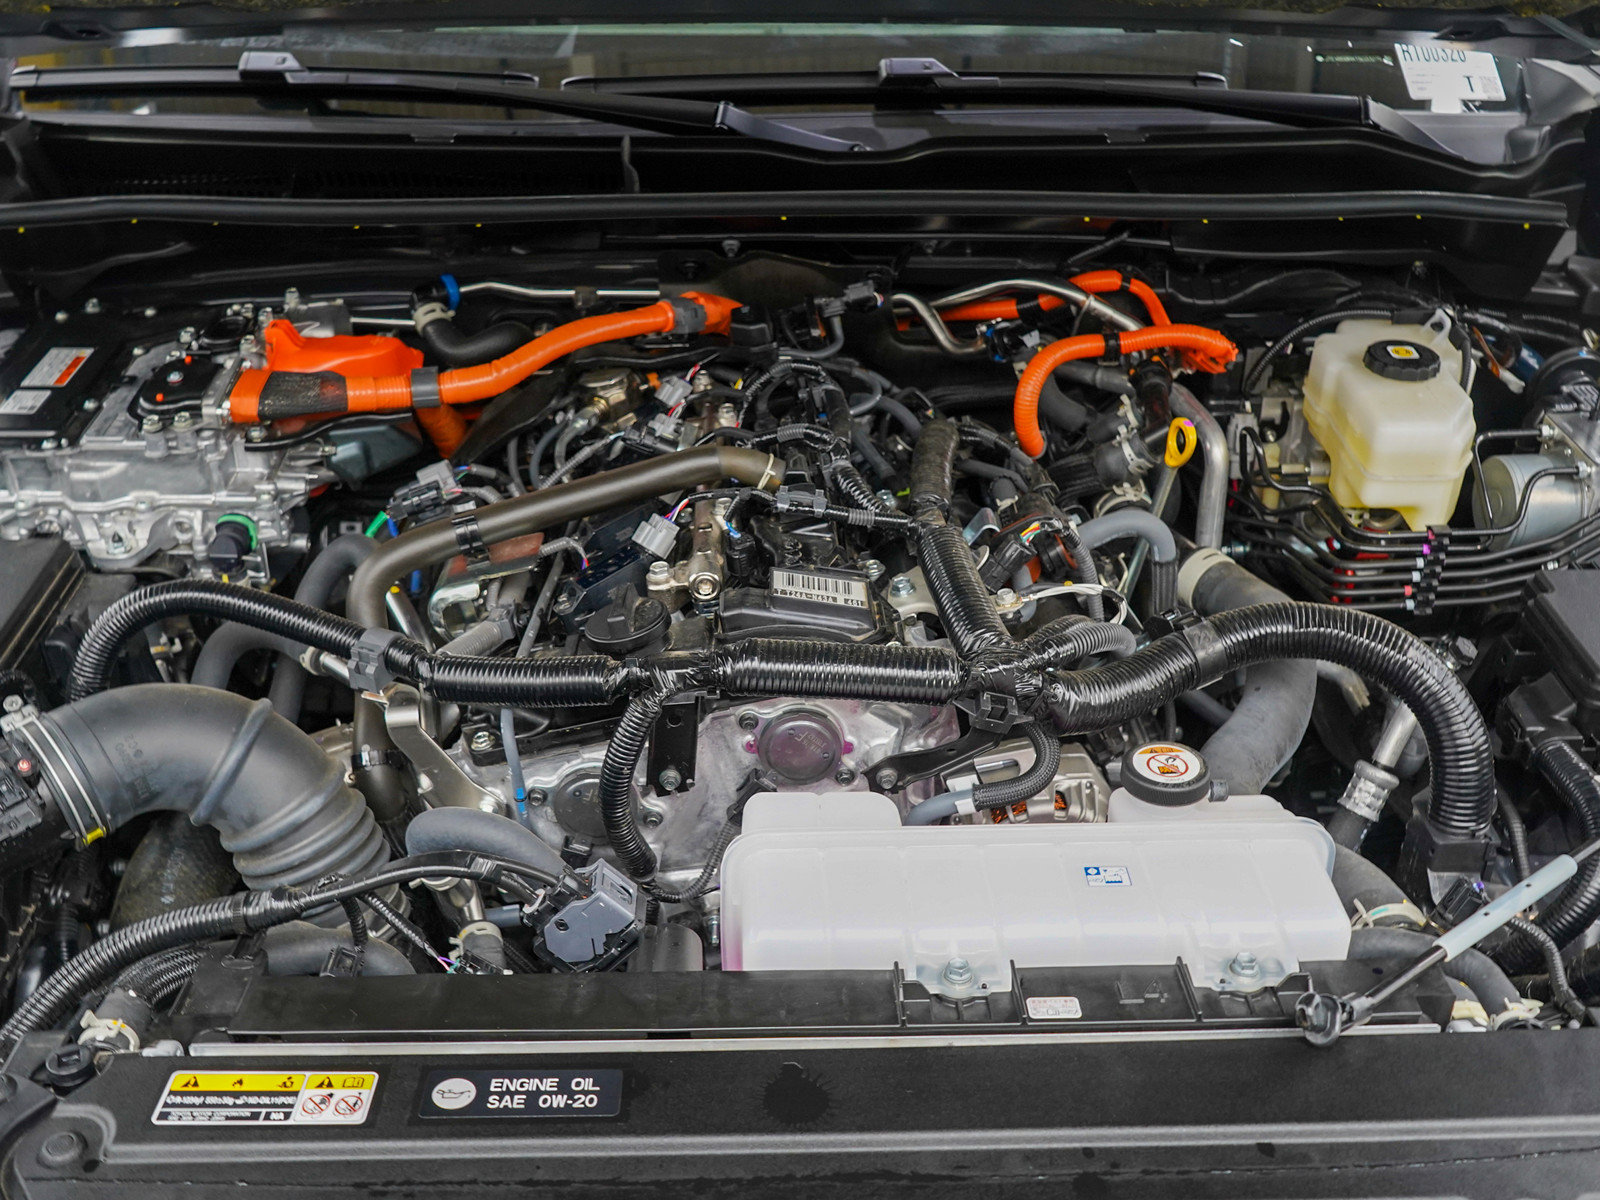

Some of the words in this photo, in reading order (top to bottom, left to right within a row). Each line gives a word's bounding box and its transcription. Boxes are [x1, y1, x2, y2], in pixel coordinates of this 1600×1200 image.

[1463, 75, 1474, 93] T
[489, 1078, 560, 1092] ENGINE
[571, 1077, 601, 1091] OIL
[486, 1094, 527, 1109] SAE
[538, 1094, 598, 1108] 0W-20
